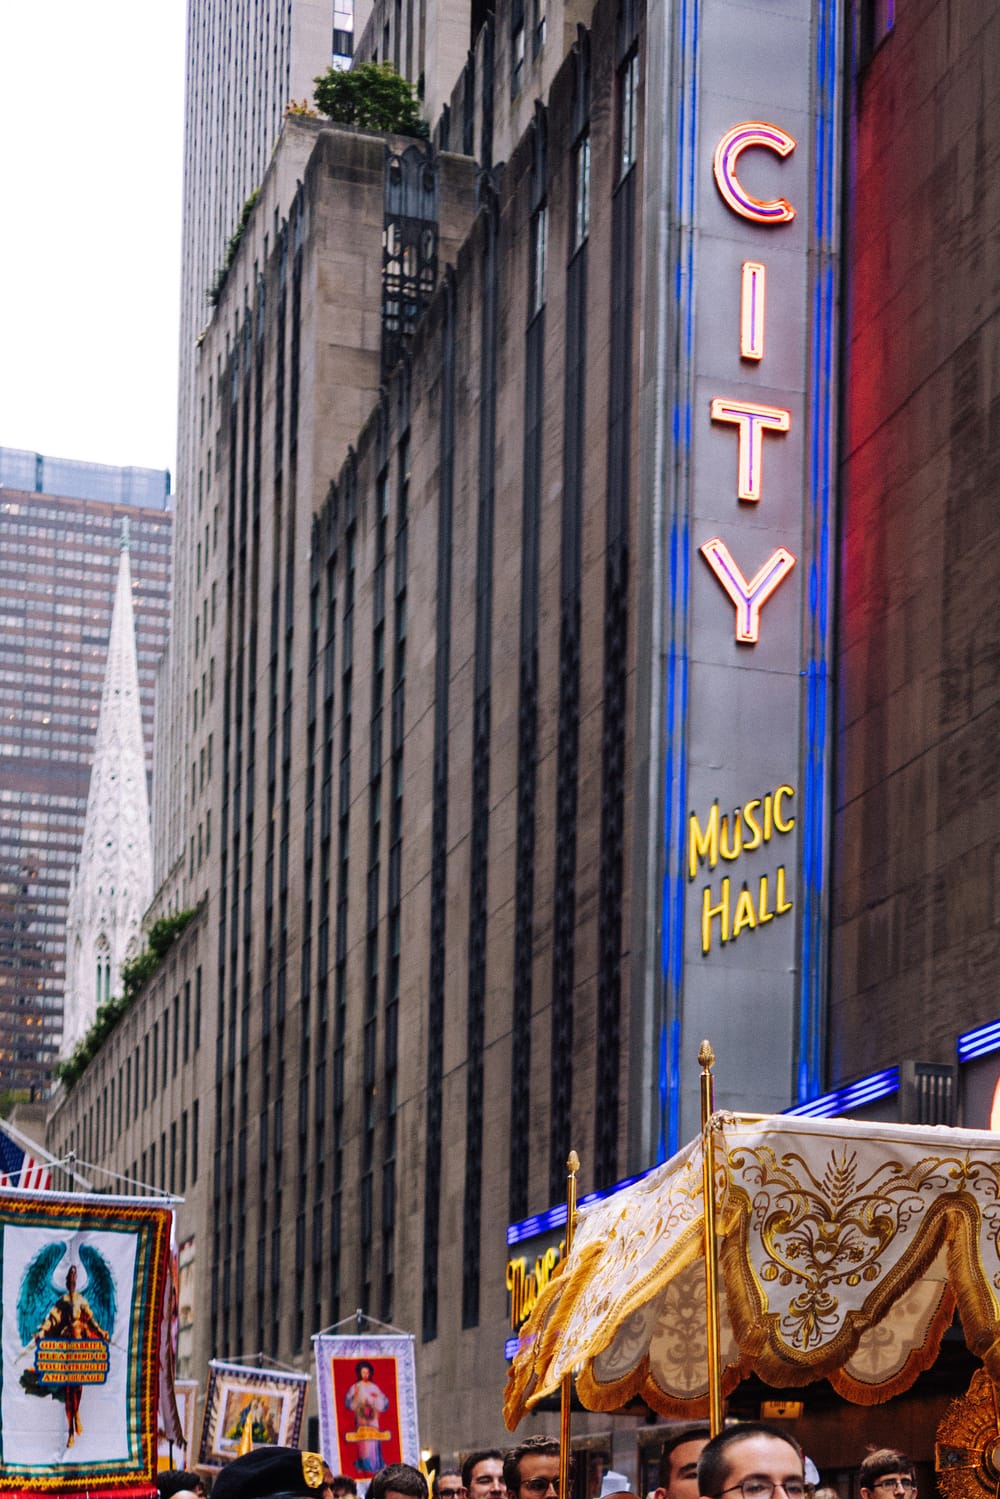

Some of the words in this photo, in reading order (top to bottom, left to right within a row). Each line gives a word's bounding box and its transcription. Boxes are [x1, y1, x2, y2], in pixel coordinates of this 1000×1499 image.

[702, 120, 796, 645] CITY
[688, 783, 796, 882] MUSIC
[701, 864, 793, 957] HALL
